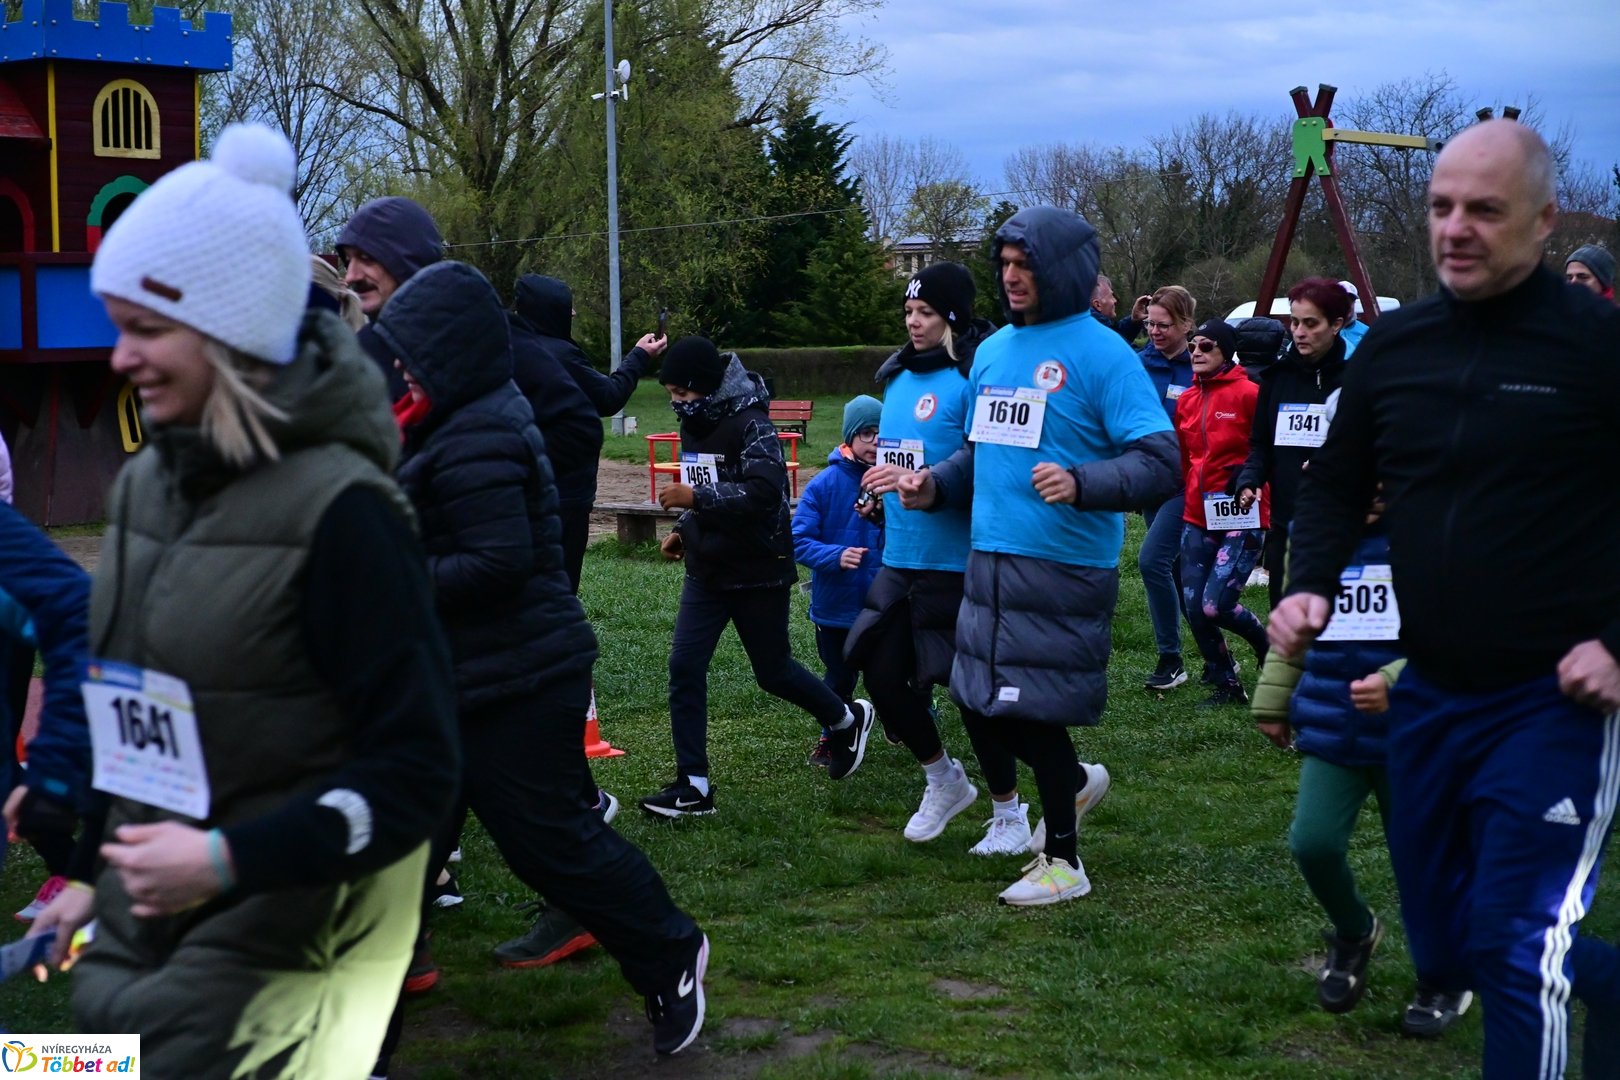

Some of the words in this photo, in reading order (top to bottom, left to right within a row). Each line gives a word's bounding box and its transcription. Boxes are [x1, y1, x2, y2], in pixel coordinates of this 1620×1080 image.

[988, 400, 1030, 426] 1610
[1288, 414, 1320, 432] 1341
[883, 451, 914, 470] 1608
[686, 465, 711, 486] 1465
[1334, 584, 1388, 614] 503
[110, 697, 180, 760] 1641
